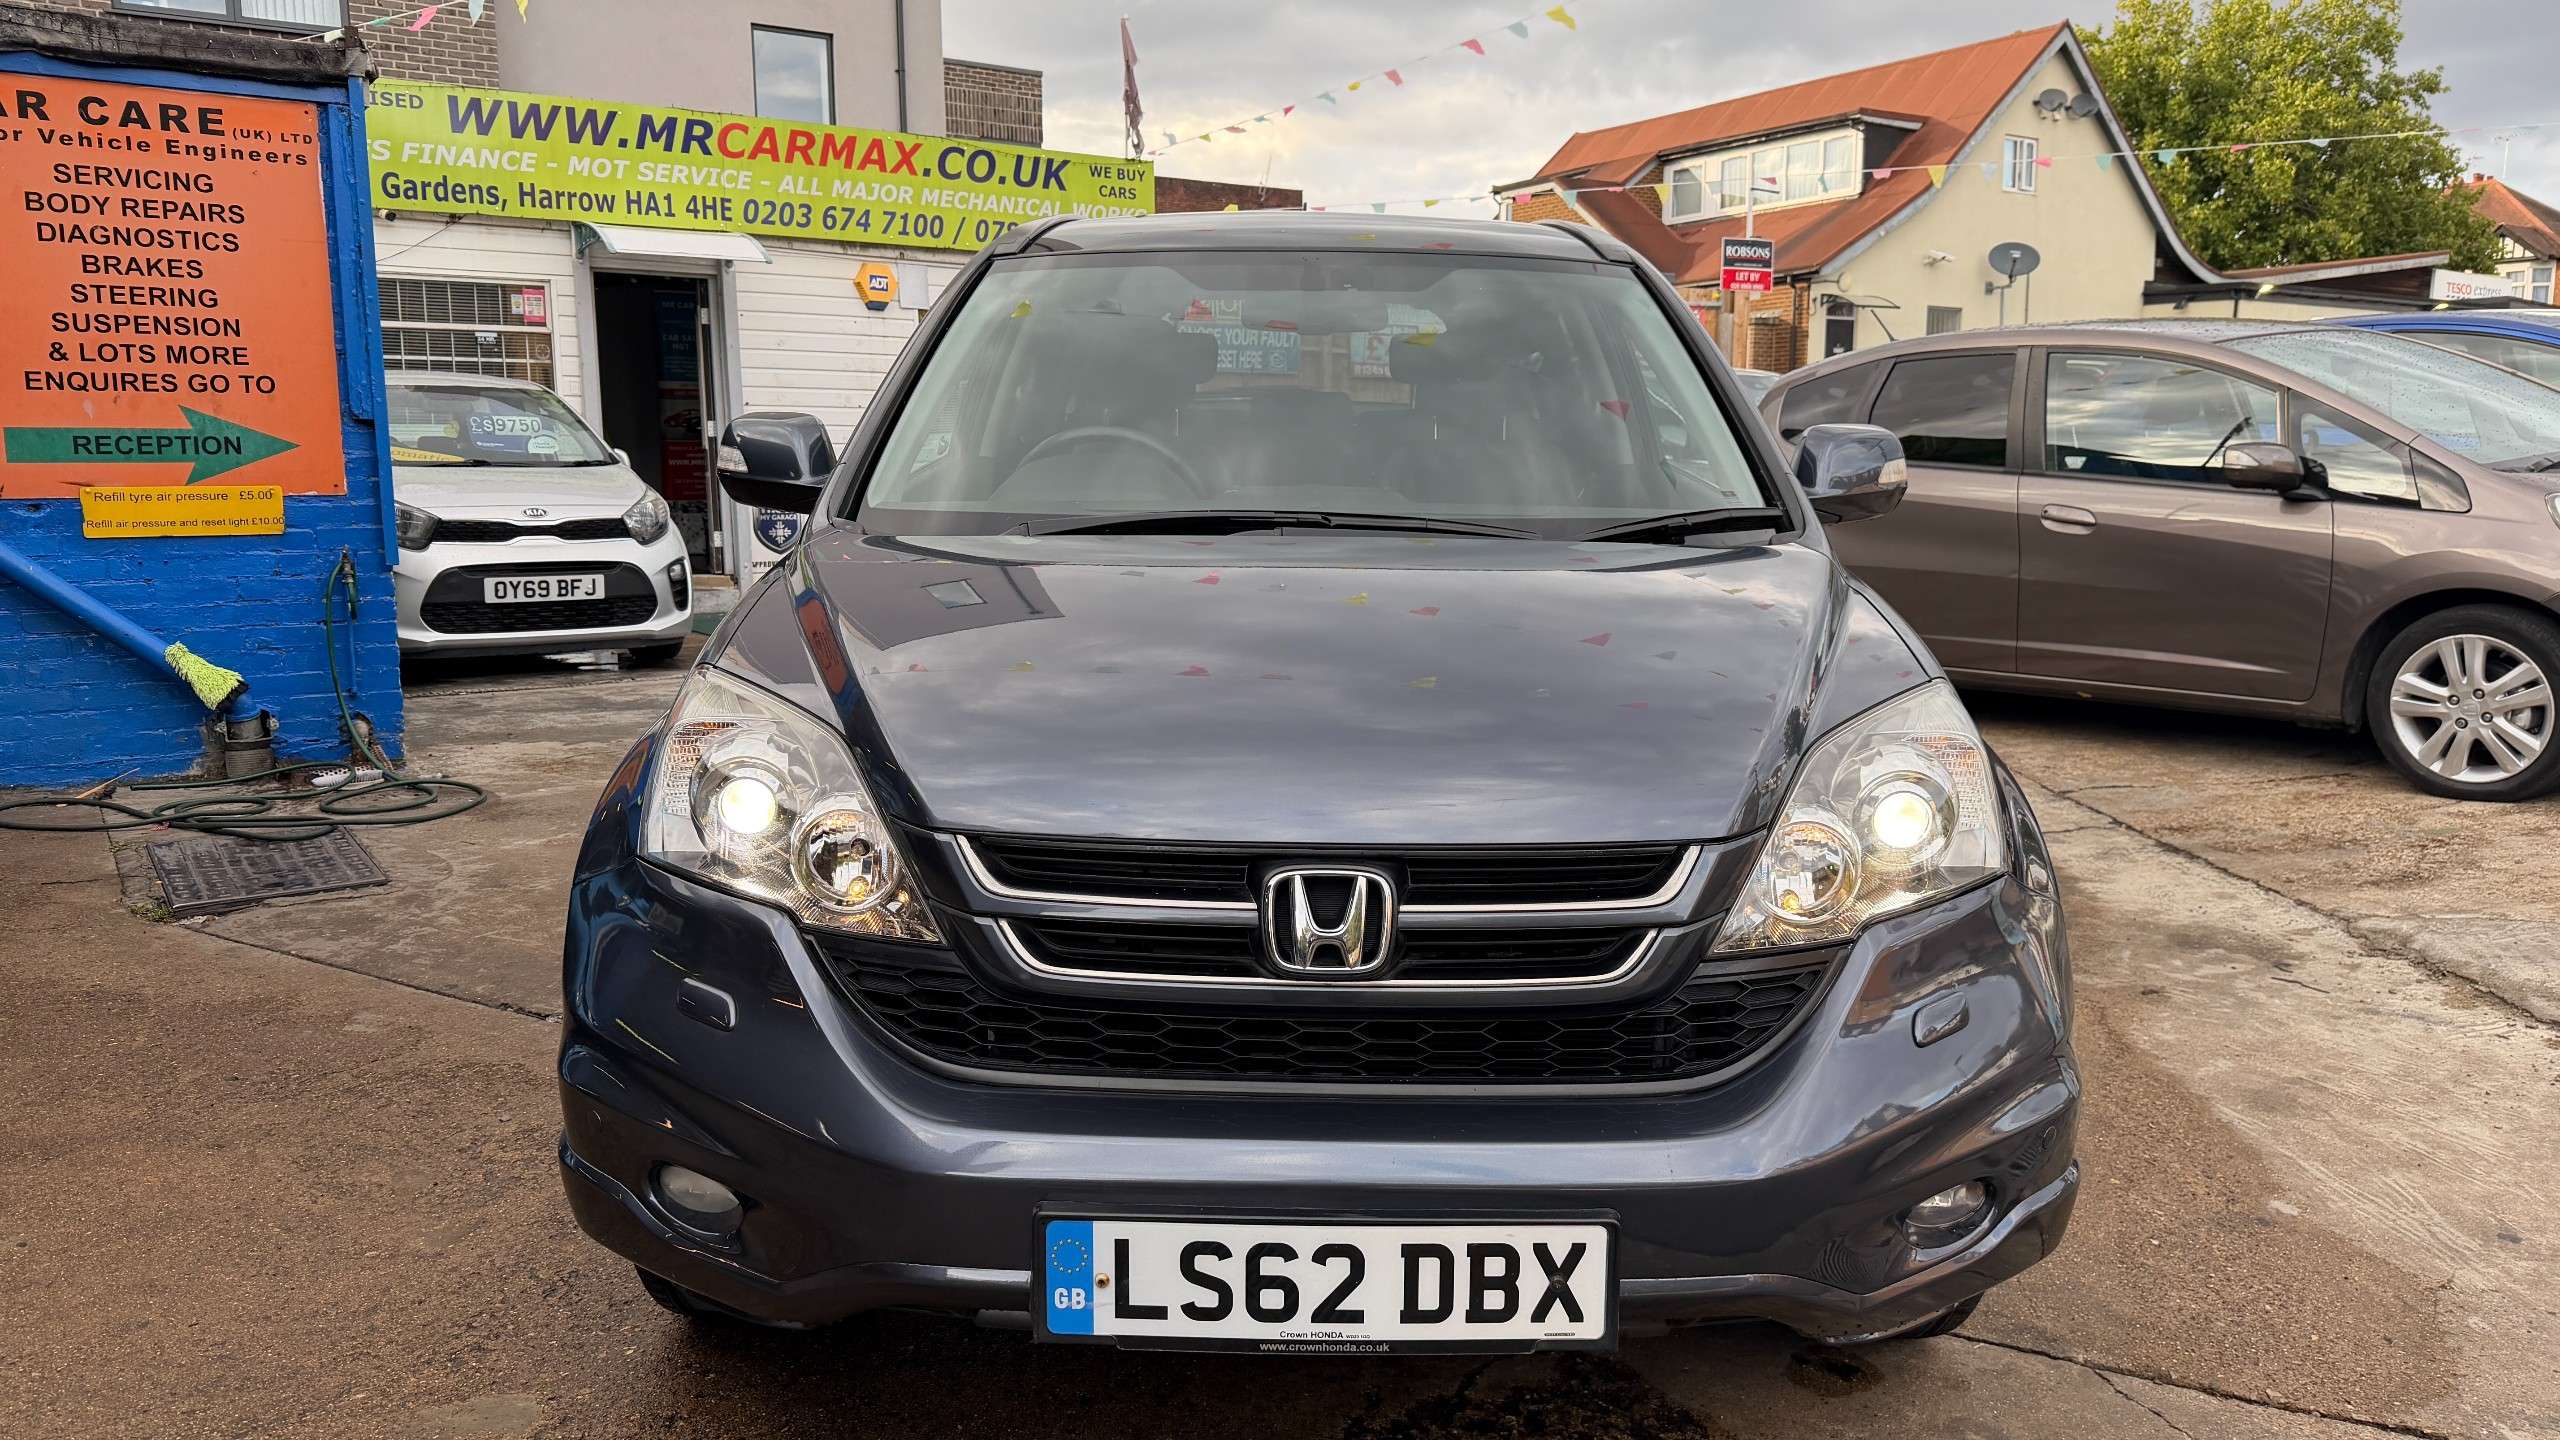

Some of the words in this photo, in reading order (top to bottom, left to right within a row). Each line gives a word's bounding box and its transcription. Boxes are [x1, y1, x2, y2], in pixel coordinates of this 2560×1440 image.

[78, 96, 225, 136] CARE
[232, 127, 272, 144] (UK)
[280, 132, 313, 145] LTD
[37, 128, 151, 153] Vehicle
[166, 139, 308, 166] Engineers
[447, 95, 1072, 192] WWW.MRCARMAX.CO.UK
[53, 163, 214, 193] SERVICING
[402, 142, 538, 172] FINANCE
[568, 156, 634, 180] MOT
[637, 162, 752, 190] SERVICE
[777, 175, 823, 197] ALL
[831, 181, 913, 204] MAJOR
[920, 188, 1062, 217] MECHANICAL
[1089, 165, 1113, 180] WE
[1117, 168, 1146, 183] BUY
[1099, 185, 1137, 200] CARS
[24, 191, 110, 216] BODY
[121, 197, 245, 224] REPAIRS
[381, 172, 507, 212] Gardens,
[519, 182, 615, 213] Harrow
[626, 190, 676, 219] HA1
[686, 194, 732, 222] 4HE
[743, 199, 812, 230] 0203
[822, 206, 872, 233] 674
[882, 210, 944, 240] 7100
[36, 222, 240, 253] DIAGNOSTICS
[1726, 246, 1770, 259] ROBSONS
[81, 254, 204, 279] BRAKES
[871, 276, 888, 290] ADT
[2447, 282, 2472, 295] TESCO
[70, 283, 218, 308] STEERING
[51, 312, 241, 337] SUSPENSION
[1223, 328, 1257, 346] YOUR
[1261, 330, 1296, 347] FAULT
[49, 342, 69, 361] &
[79, 343, 156, 363] LOTS
[166, 346, 250, 366] MORE
[1239, 351, 1262, 369] HERE
[24, 371, 178, 393] ENQUIRES
[187, 374, 231, 394] GO
[238, 375, 276, 394] TO
[72, 435, 242, 456] RECEPTION
[94, 491, 125, 502] Refill
[129, 492, 153, 503] tyre
[157, 491, 171, 501] air
[176, 492, 228, 503] pressure
[239, 490, 273, 501] £5.00
[86, 519, 113, 529] Refill
[115, 519, 129, 528] air
[132, 519, 176, 529] pressure
[179, 518, 198, 527] and
[201, 518, 226, 526] reset
[229, 517, 249, 527] light
[251, 516, 284, 526] £10.00
[525, 508, 545, 517] KIA
[494, 580, 550, 600] OY69
[557, 578, 597, 598] BFJ
[1114, 1238, 1366, 1325] LS62
[1400, 1241, 1588, 1325] DBX
[1054, 1287, 1086, 1310] GB
[1280, 1331, 1308, 1339] Crown
[1259, 1342, 1390, 1352] www.crownhonda.co.uk
